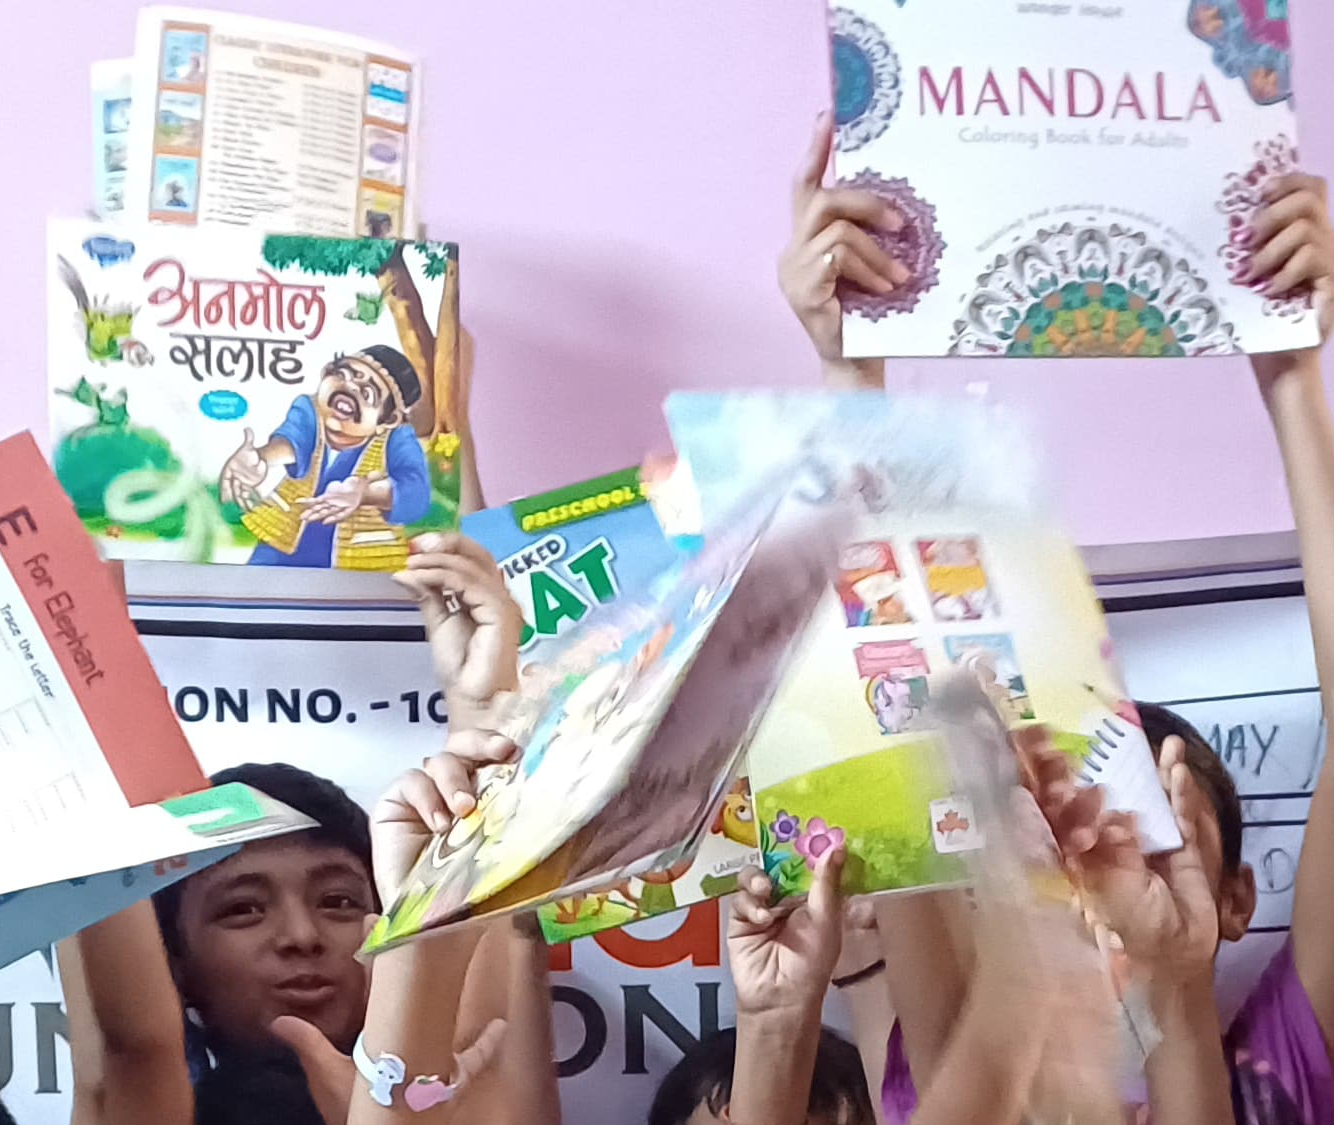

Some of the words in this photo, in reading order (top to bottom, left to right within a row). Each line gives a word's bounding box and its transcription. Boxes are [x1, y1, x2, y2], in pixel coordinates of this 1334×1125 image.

[919, 66, 1222, 122] MANDALA
[958, 127, 1039, 148] Coloring
[1046, 128, 1090, 145] Book
[1097, 127, 1125, 145] for
[1131, 132, 1188, 148] Adults
[143, 257, 327, 340] अनमोल
[170, 333, 307, 384] सलाह
[522, 486, 636, 532] PRESCHOOL
[502, 538, 561, 580] ICKED
[23, 553, 53, 589] for
[44, 590, 105, 689] Elephant
[519, 542, 615, 647] AT
[0, 603, 21, 636] Trace
[18, 639, 34, 661] the
[164, 686, 249, 722] ON
[267, 688, 356, 723] NO.
